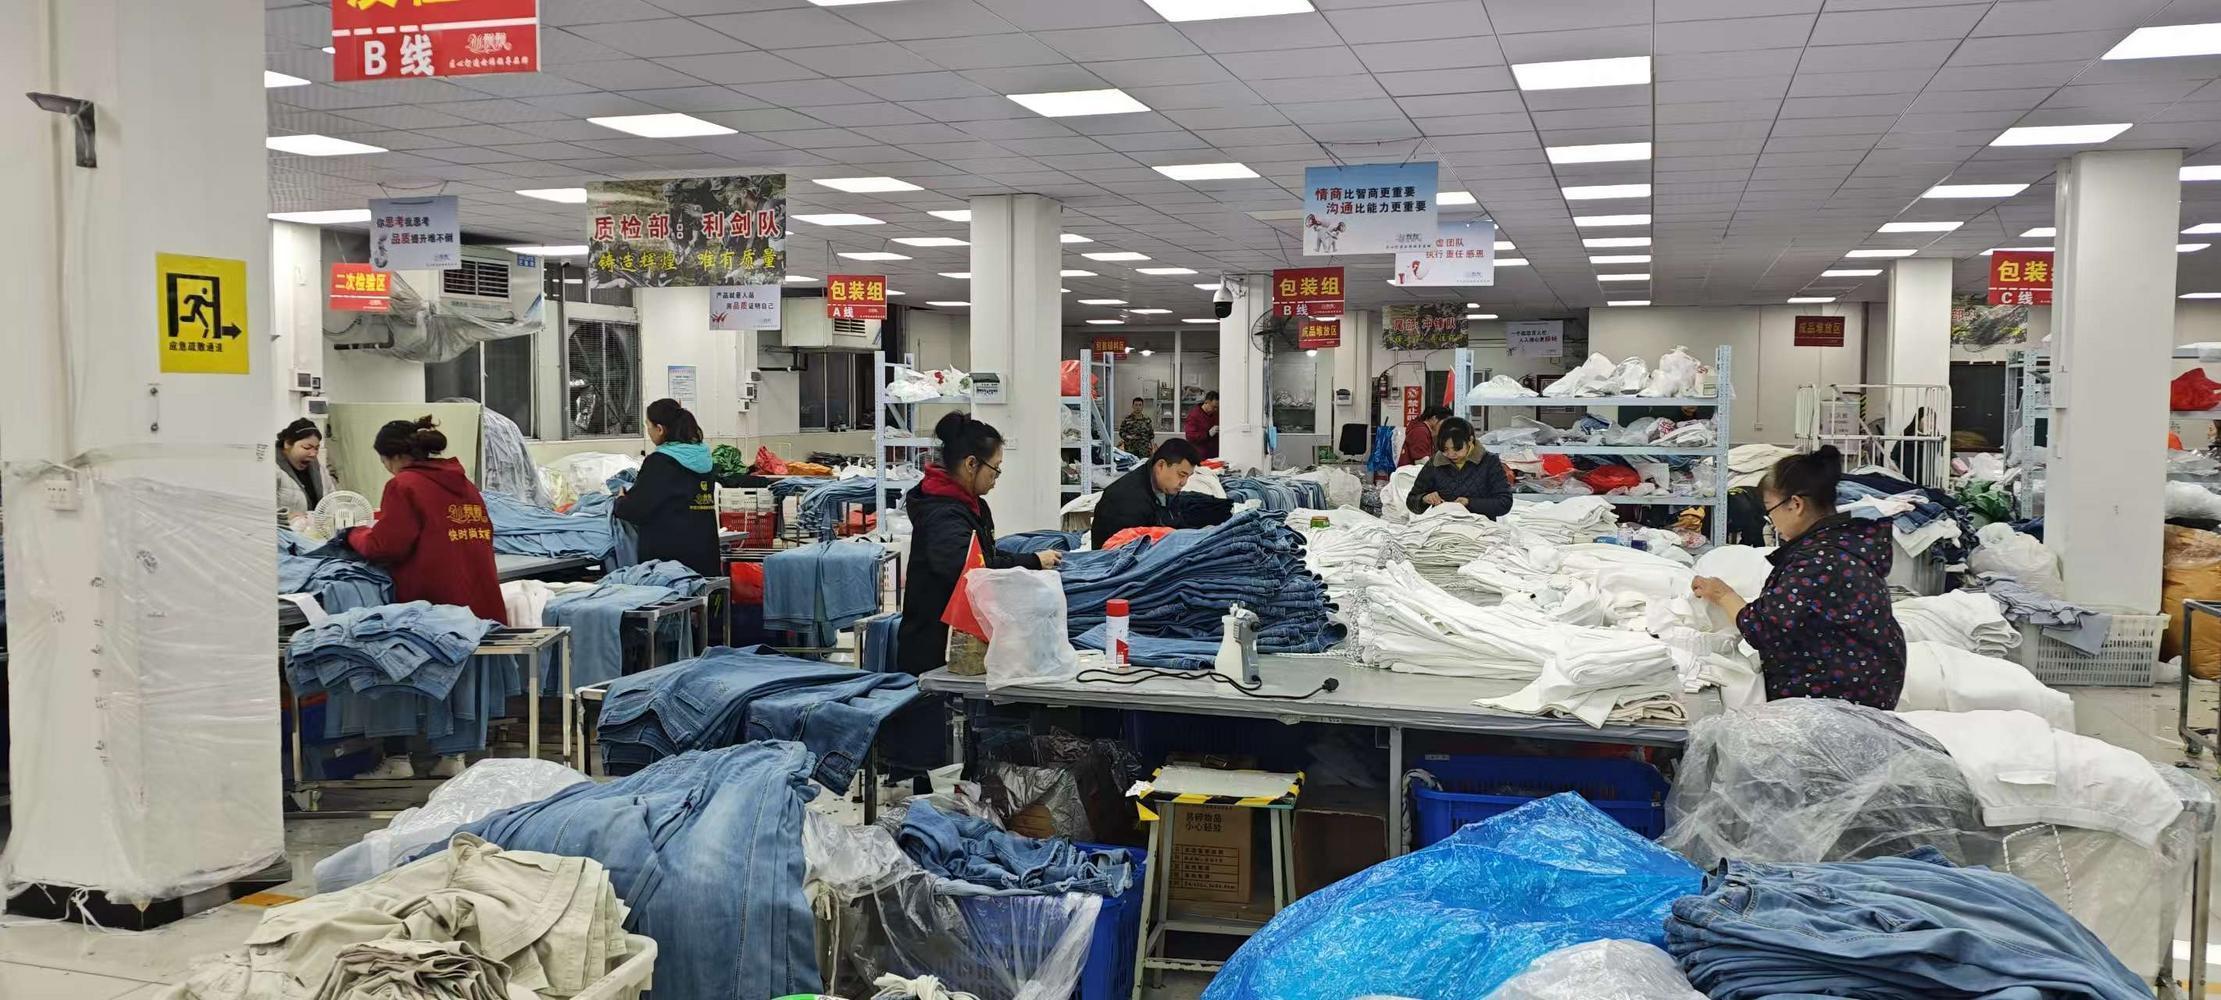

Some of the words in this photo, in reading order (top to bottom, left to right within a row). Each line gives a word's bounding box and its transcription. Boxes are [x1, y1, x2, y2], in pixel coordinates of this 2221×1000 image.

[364, 40, 387, 75] B
[400, 34, 434, 75] 线
[1315, 186, 1416, 201] 情商比智商更重要
[1326, 201, 1427, 215] 沟通比能力更重要
[376, 216, 430, 227] 你思考我思考
[593, 213, 684, 241] 质检部：
[702, 211, 780, 239] 利剑队
[391, 233, 454, 245] 品质提升难不倒
[598, 250, 677, 274] 铸造辉煌
[697, 248, 777, 272] 唯有质量
[1998, 260, 2053, 282] 包装
[335, 273, 386, 292] 二次检验区
[1280, 277, 1340, 297] 包装组
[831, 280, 883, 301] 包装组
[2001, 292, 2013, 304] C
[2017, 291, 2033, 305] 线
[832, 307, 841, 317] A
[843, 307, 854, 318] 线
[1283, 305, 1292, 316] B
[1296, 304, 1308, 316] 线
[1302, 325, 1337, 337] 成品堆放区
[169, 341, 223, 352] 应急疏散通道
